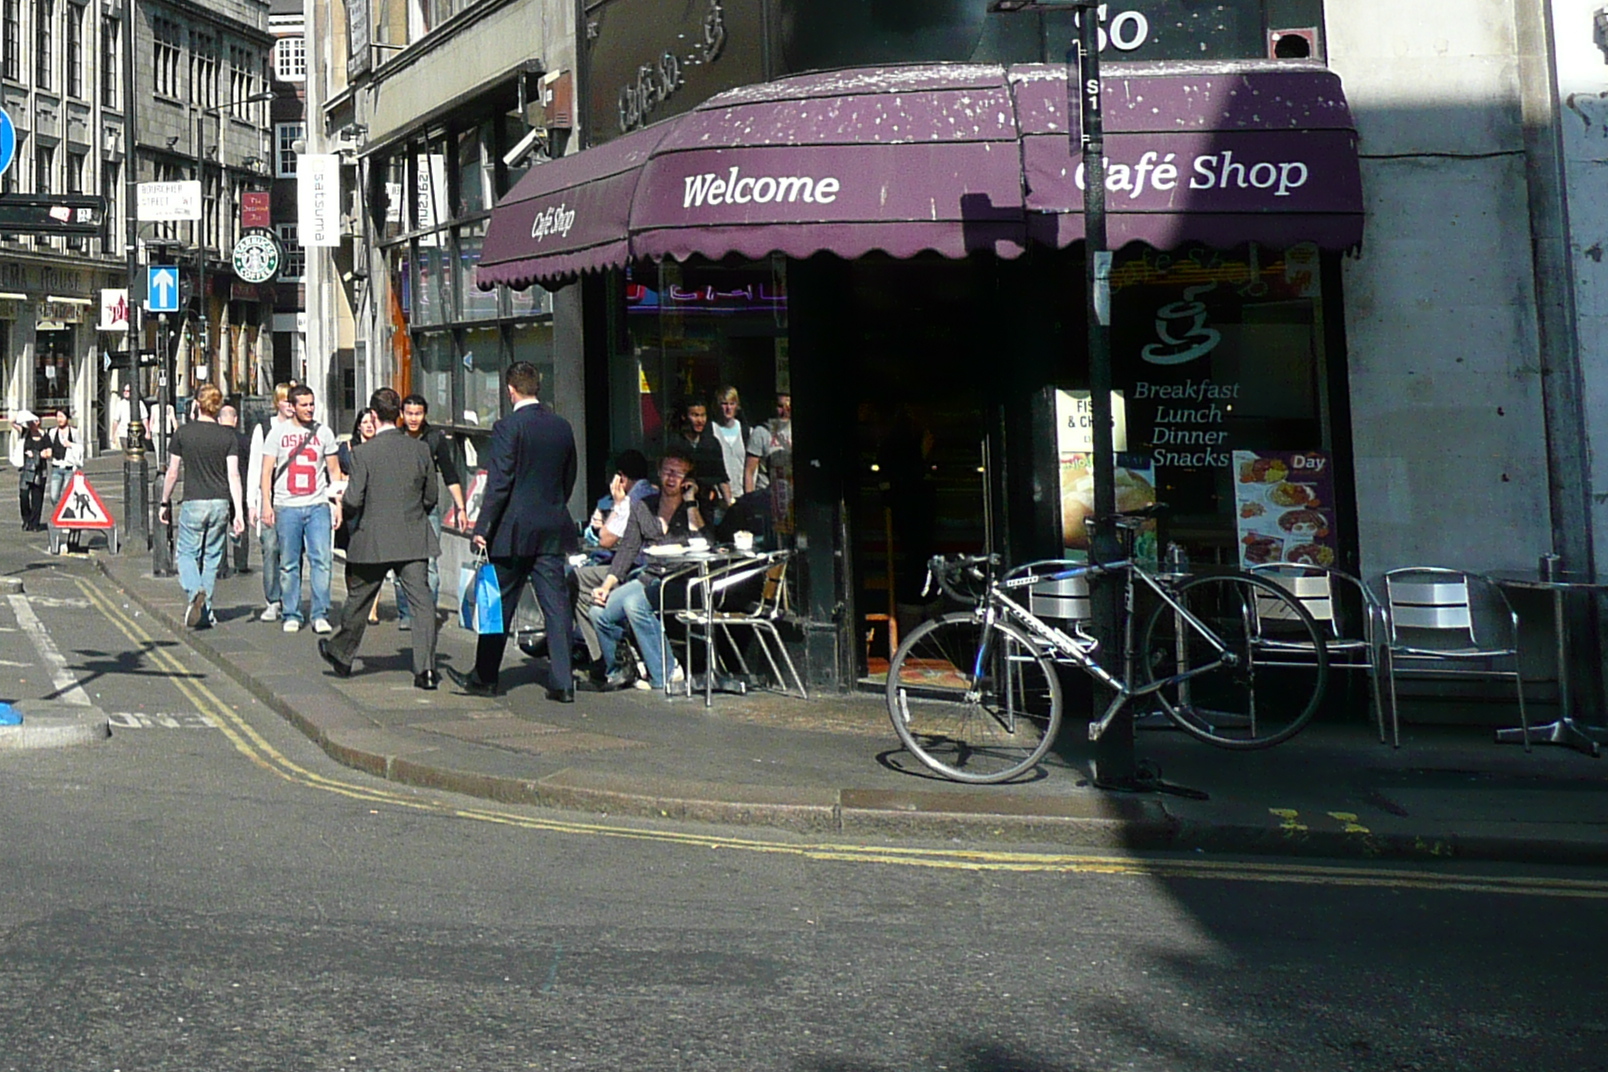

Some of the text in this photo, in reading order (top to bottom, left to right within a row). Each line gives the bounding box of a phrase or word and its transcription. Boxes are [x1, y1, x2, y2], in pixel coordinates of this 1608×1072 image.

[1086, 78, 1099, 95] S
[1088, 95, 1098, 111] 1
[1188, 150, 1309, 197] Shop
[683, 166, 840, 209] Welcome
[314, 173, 325, 241] satsuma
[531, 203, 576, 243] Café Shop
[1132, 378, 1241, 403] Breakfast
[1067, 415, 1076, 428] &
[1154, 403, 1224, 424] Lunch
[1151, 427, 1229, 446] Dinner
[1152, 447, 1231, 468] Snacks
[1292, 454, 1327, 472] Day
[287, 447, 318, 496] 6
